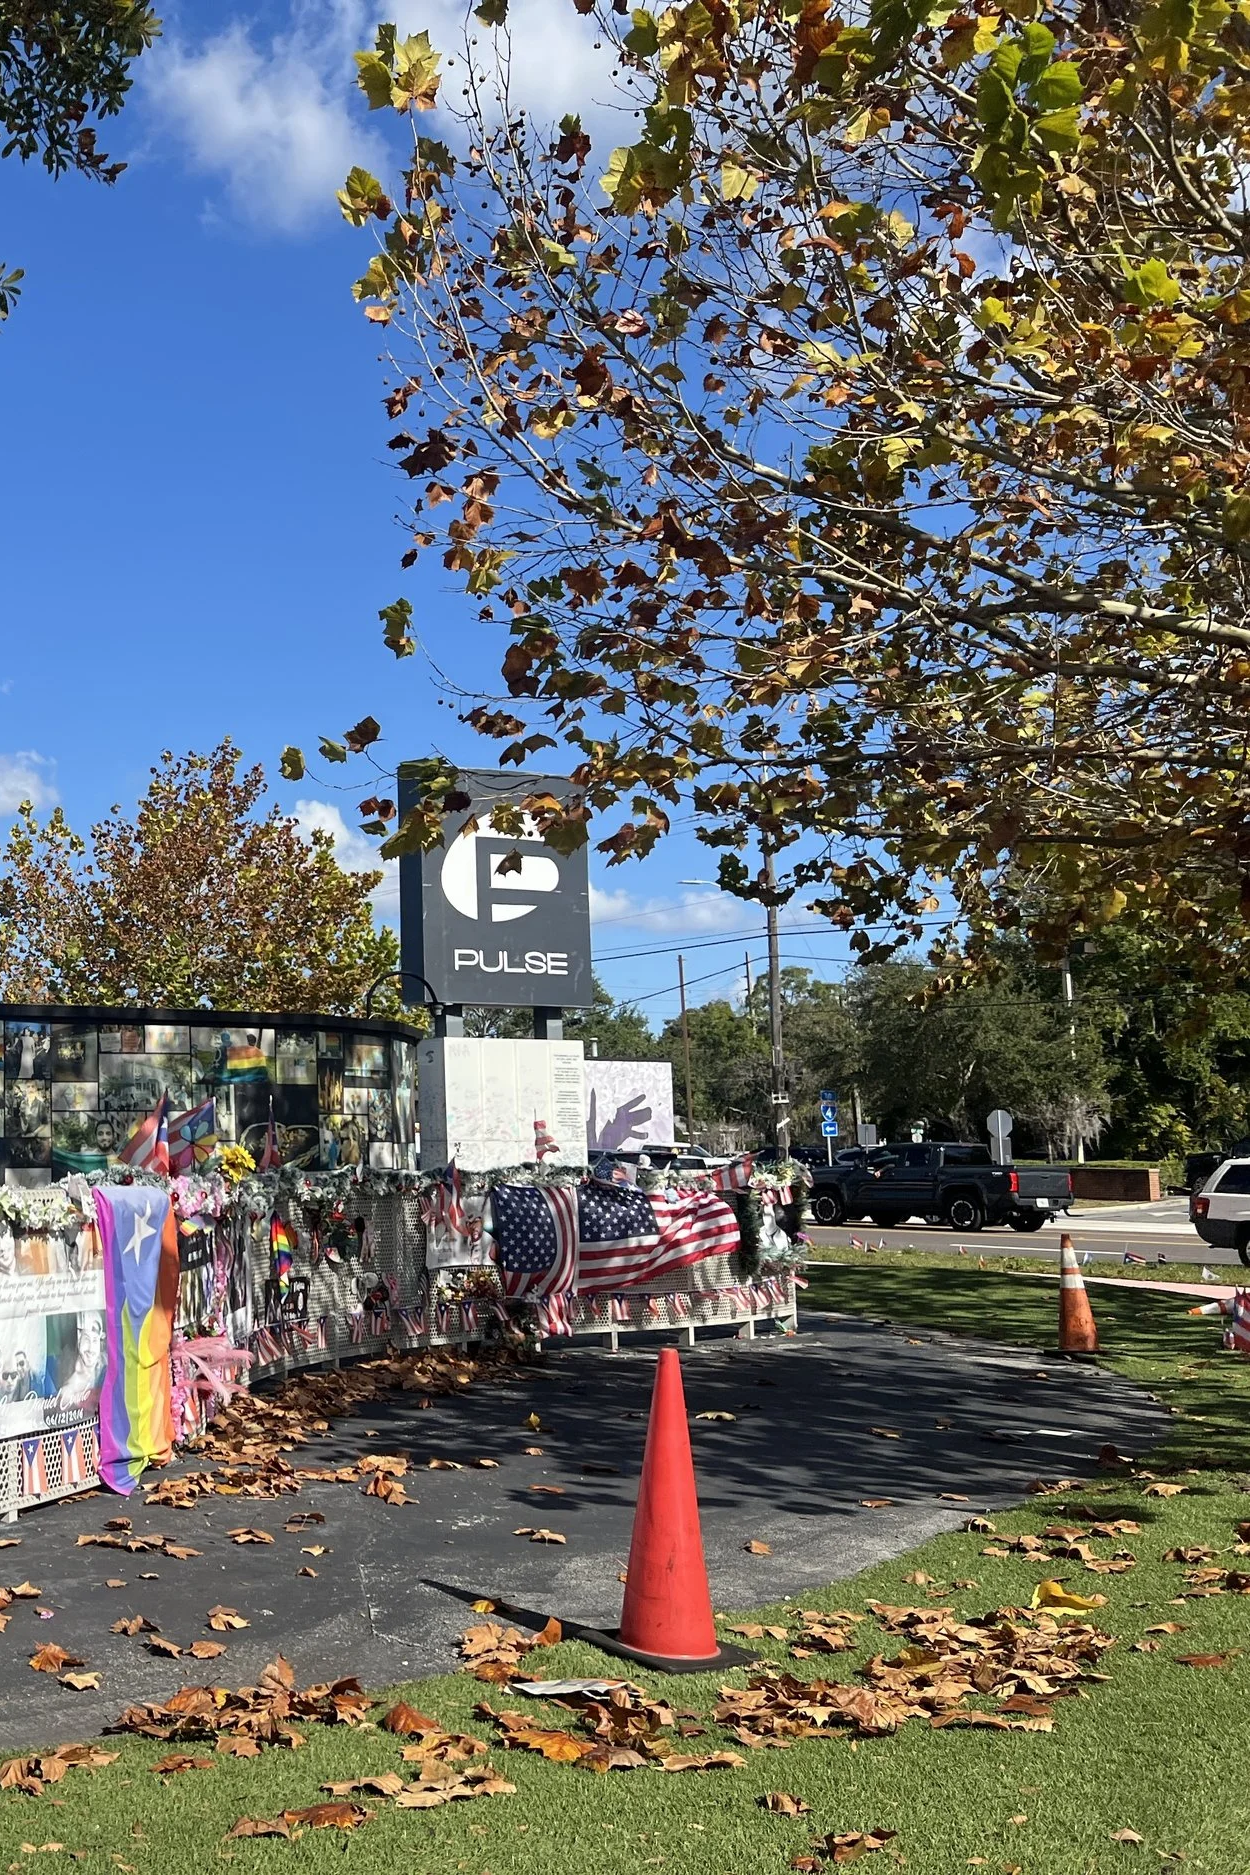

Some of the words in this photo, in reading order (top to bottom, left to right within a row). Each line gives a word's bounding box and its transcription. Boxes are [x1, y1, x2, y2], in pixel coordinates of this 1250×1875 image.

[453, 948, 569, 977] PULSE
[825, 1106, 833, 1119] 4
[23, 1387, 62, 1415] Daniel
[45, 1407, 85, 1427] 06/12/2016
